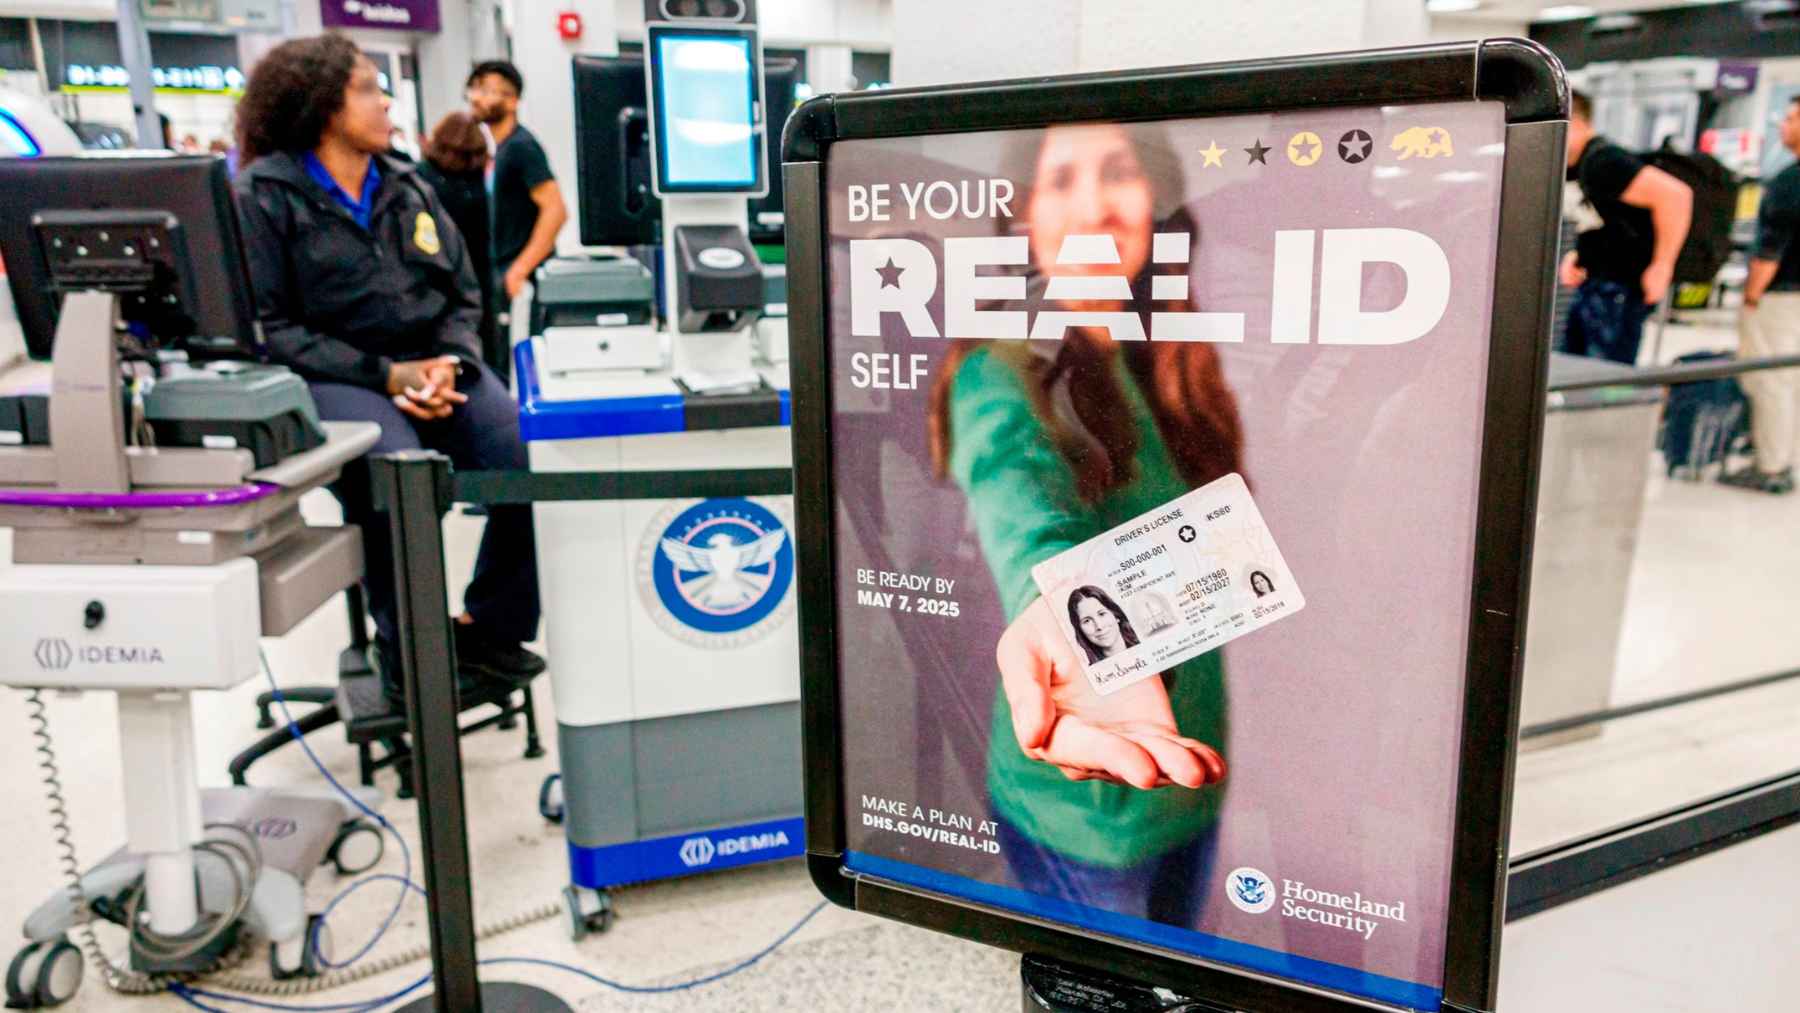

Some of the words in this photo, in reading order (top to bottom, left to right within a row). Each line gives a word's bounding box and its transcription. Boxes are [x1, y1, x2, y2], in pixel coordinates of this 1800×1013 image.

[848, 183, 891, 223] BE
[898, 178, 1015, 220] YOUR
[850, 231, 1246, 344] REAL
[1270, 228, 1452, 345] ID
[850, 350, 929, 390] SELF
[1150, 508, 1184, 531] LICENSE
[857, 568, 876, 585] BE
[879, 570, 931, 592] READY
[935, 577, 955, 595] BY
[1116, 569, 1146, 587] SAMPLE
[1189, 577, 1231, 601] 02/15/2027
[857, 590, 894, 609] MAY
[917, 597, 960, 618] 2025
[79, 645, 164, 664] IDEMIA
[861, 794, 908, 817] MAKE
[912, 805, 925, 821] A
[929, 808, 972, 831] PLAN
[978, 820, 999, 837] AT
[716, 830, 790, 856] IDEMIA
[862, 813, 1001, 854] DHS.GOV/REAL-ID
[1281, 878, 1407, 922] Homeland
[1281, 898, 1379, 940] Security
